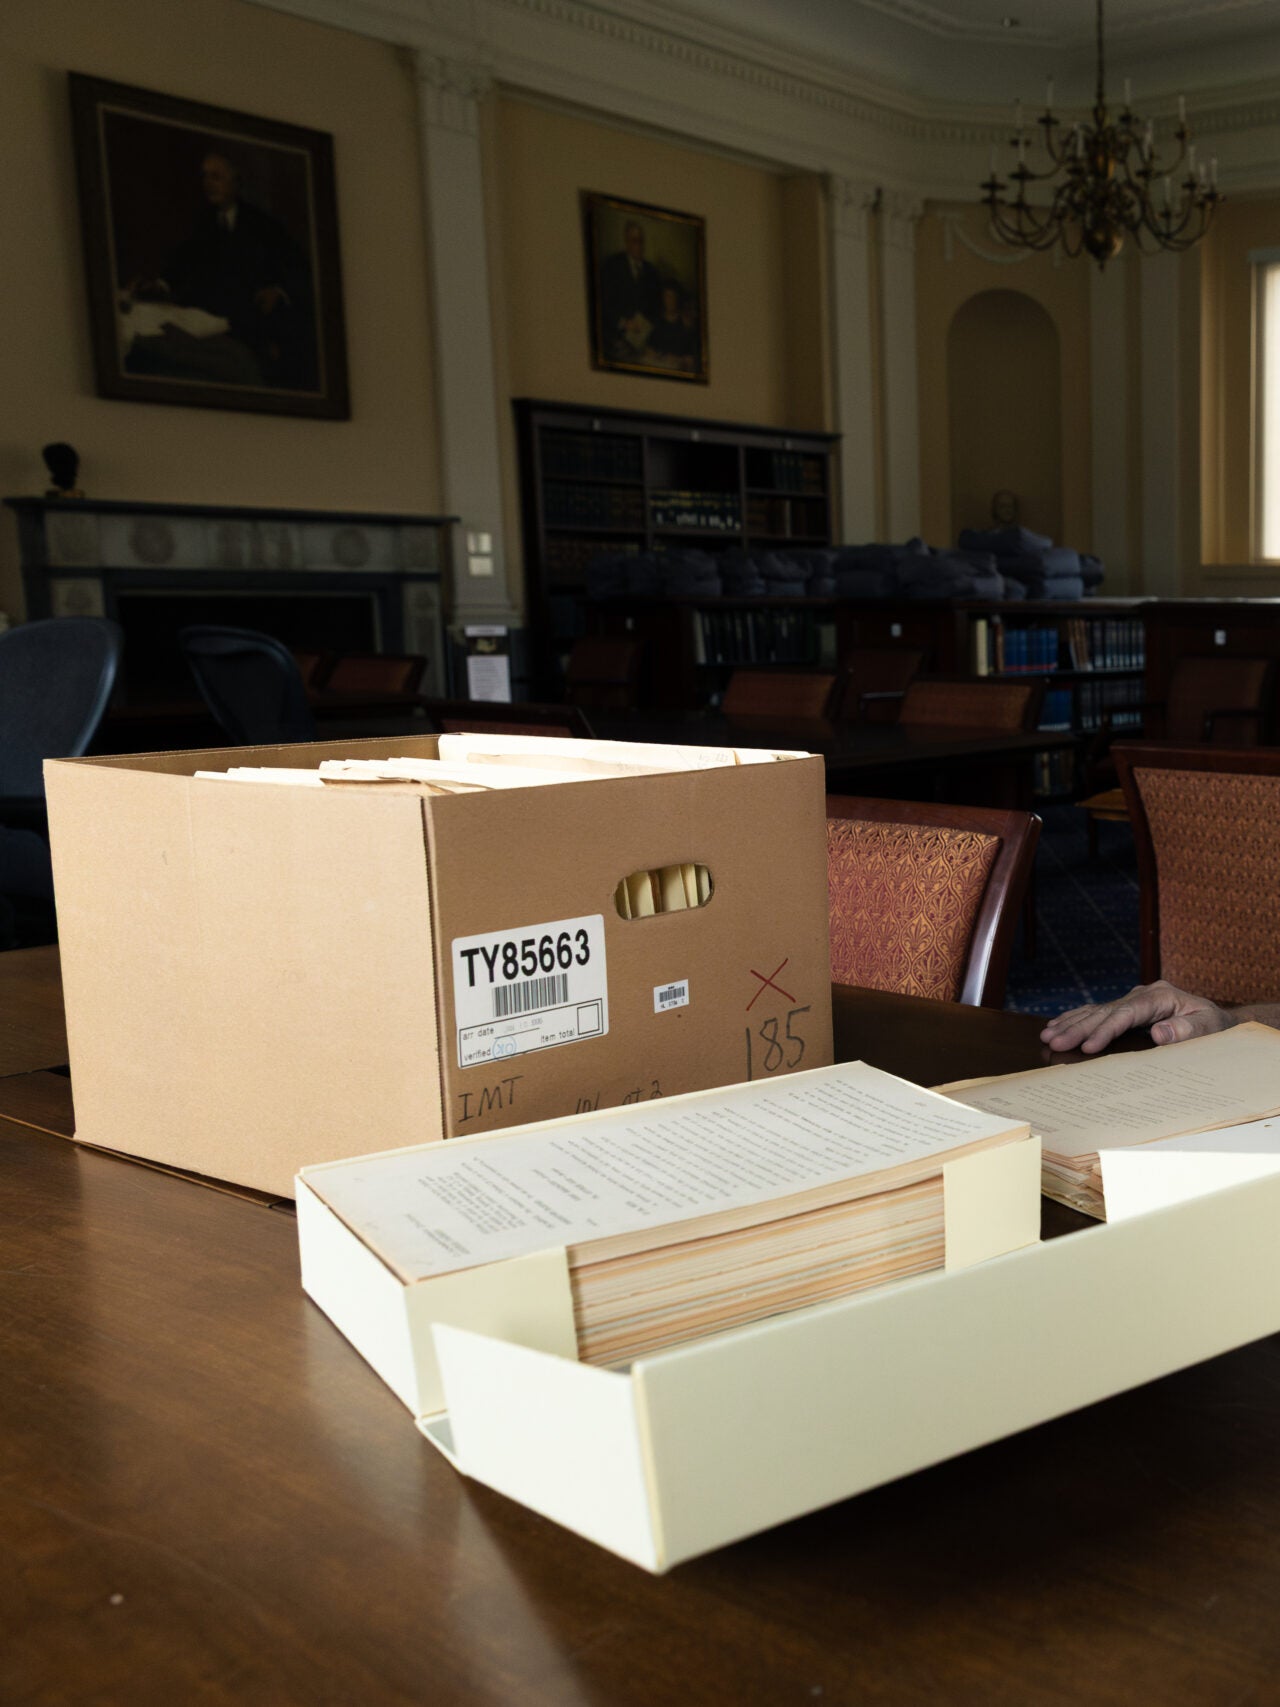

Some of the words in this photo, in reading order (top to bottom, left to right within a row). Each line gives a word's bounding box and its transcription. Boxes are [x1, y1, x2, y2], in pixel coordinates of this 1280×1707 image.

[460, 929, 590, 987] TY85663
[478, 1026, 495, 1037] date
[559, 1027, 576, 1039] total
[746, 1005, 812, 1081] 185
[463, 1048, 492, 1062] verified
[458, 1075, 524, 1123] IMT
